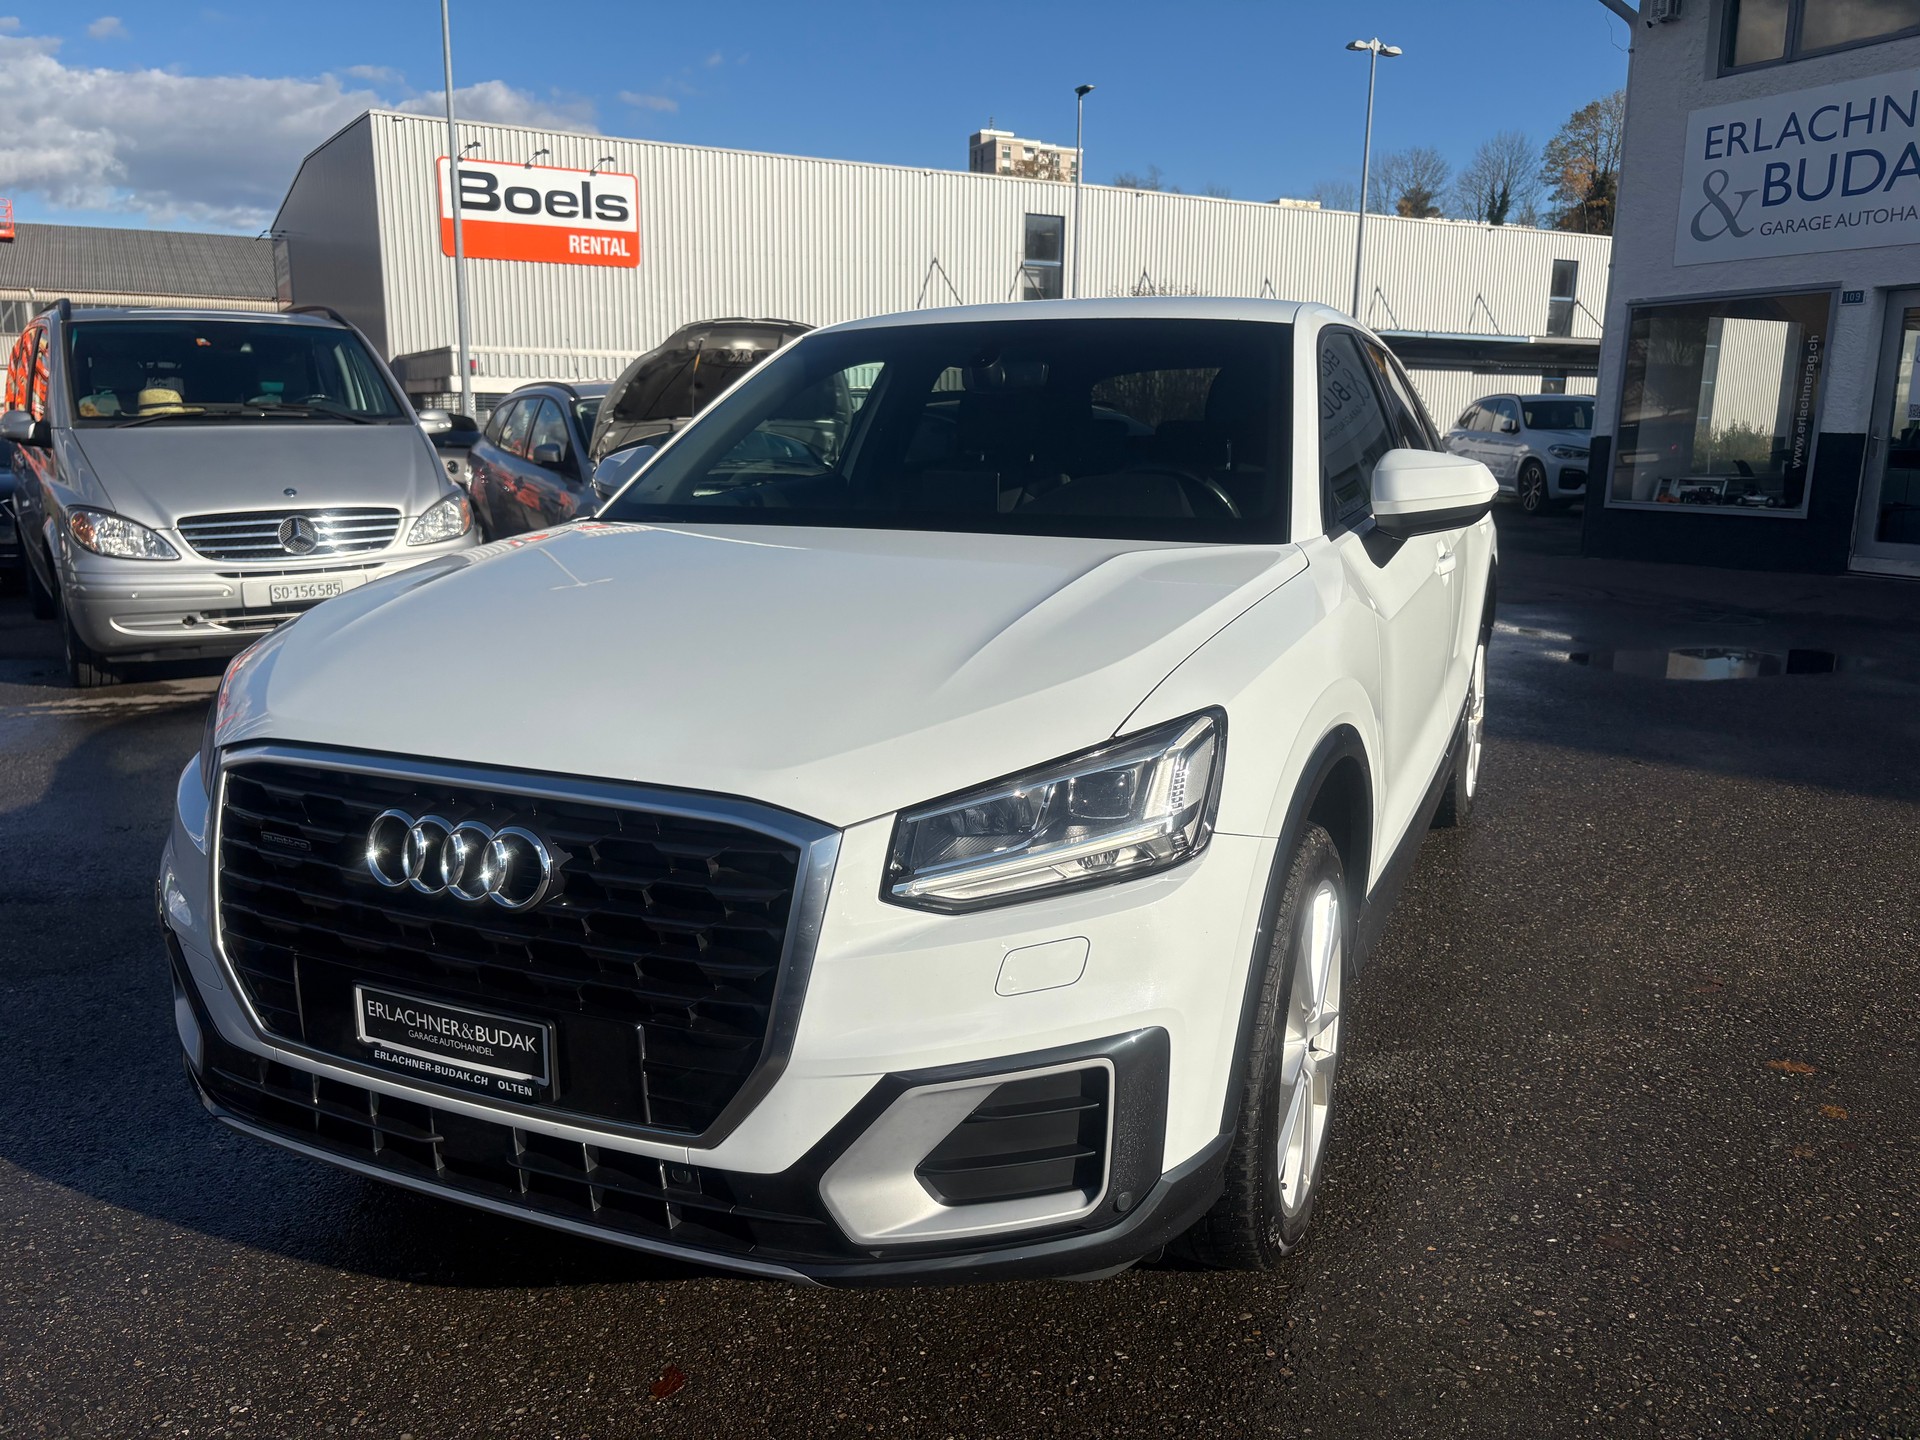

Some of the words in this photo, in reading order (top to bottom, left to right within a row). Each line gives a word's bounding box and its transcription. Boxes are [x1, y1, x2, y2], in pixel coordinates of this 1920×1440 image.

[1704, 89, 1919, 161] ERLACHN
[450, 168, 629, 222] Boels
[1690, 169, 1759, 242] &
[1761, 141, 1920, 207] BUDA
[568, 234, 630, 257] RENTAL
[1760, 215, 1832, 236] GARAGE
[1834, 205, 1919, 228] AUTOHA
[1845, 292, 1861, 301] 109
[1792, 335, 1819, 469] www.erlachnerag.ch
[367, 1000, 538, 1054] ERLACHNER&BUDAK
[408, 1029, 439, 1045] GARAGE
[439, 1037, 495, 1057] AUTOHANDEL
[374, 1050, 489, 1086] ERLACHNER-BUDAK.CH
[497, 1080, 533, 1097] OLTEN
